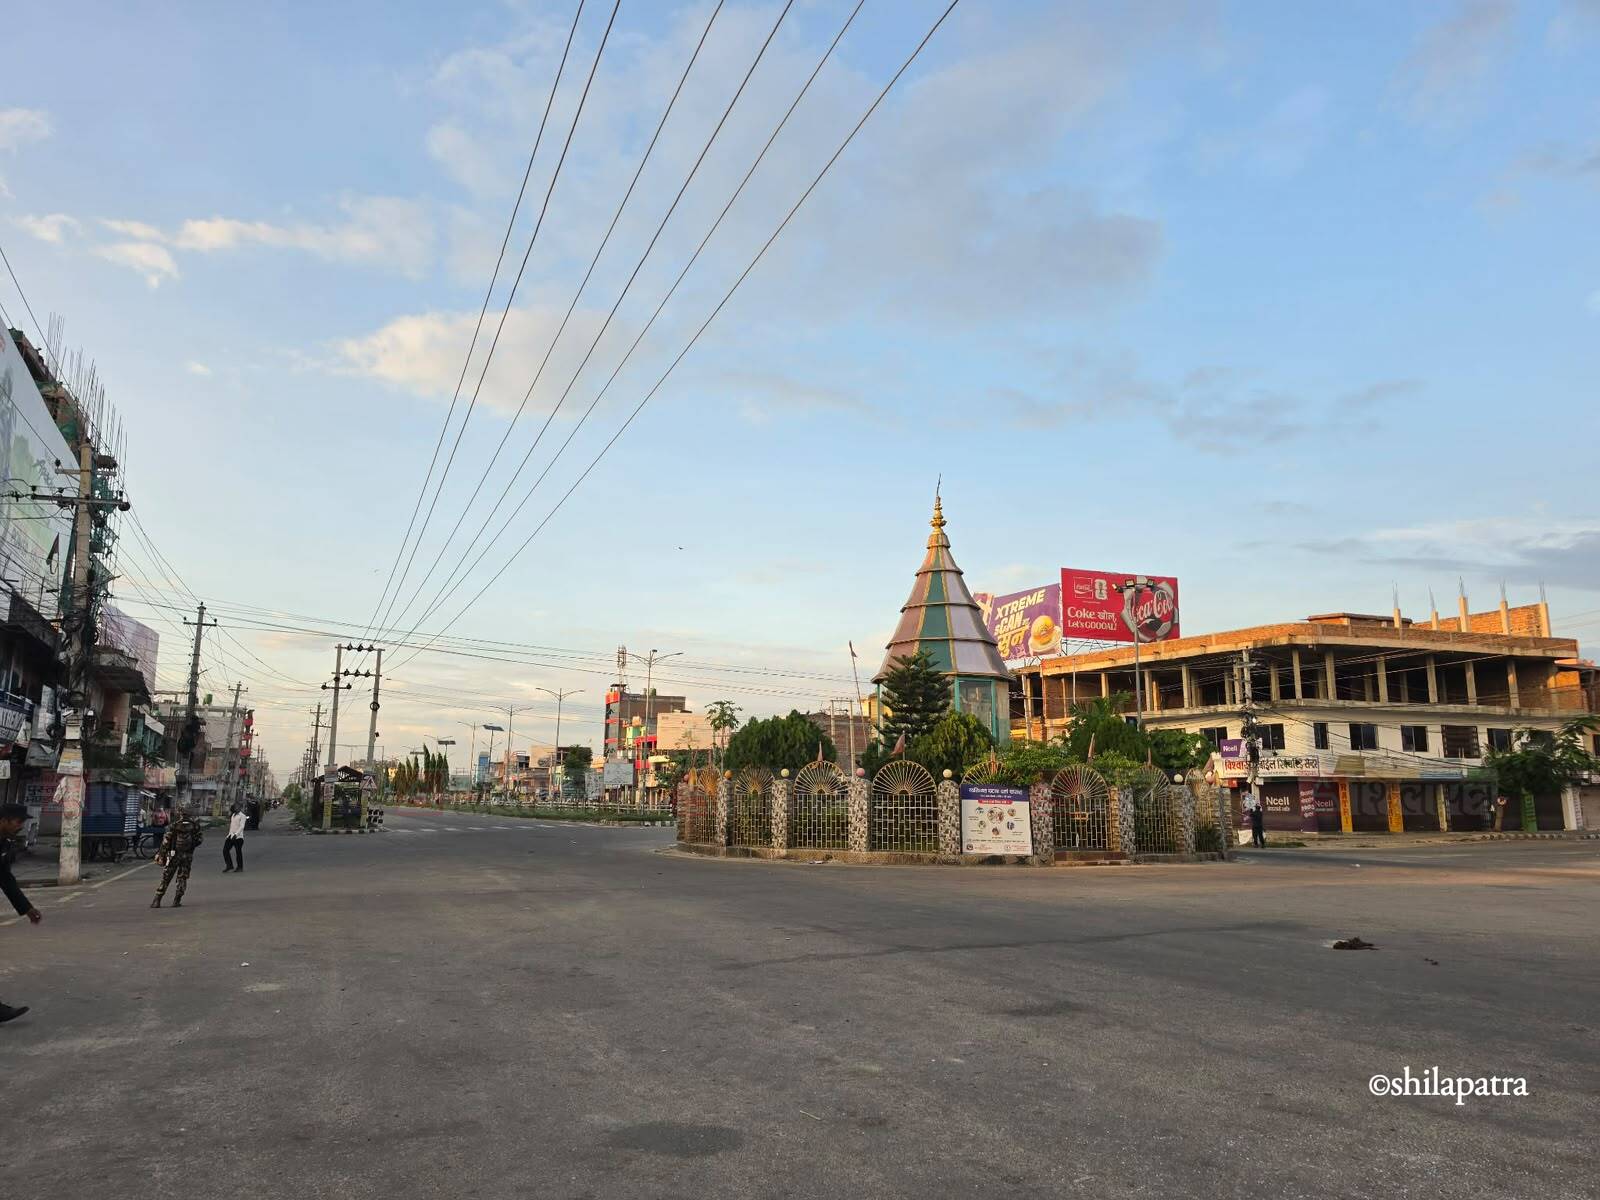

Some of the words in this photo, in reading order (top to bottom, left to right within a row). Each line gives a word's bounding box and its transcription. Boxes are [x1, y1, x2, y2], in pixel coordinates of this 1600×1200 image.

[994, 588, 1047, 621] XTREME
[1067, 606, 1096, 619] Coke
[1068, 619, 1085, 628] Let's
[1265, 796, 1290, 806] Ncell
